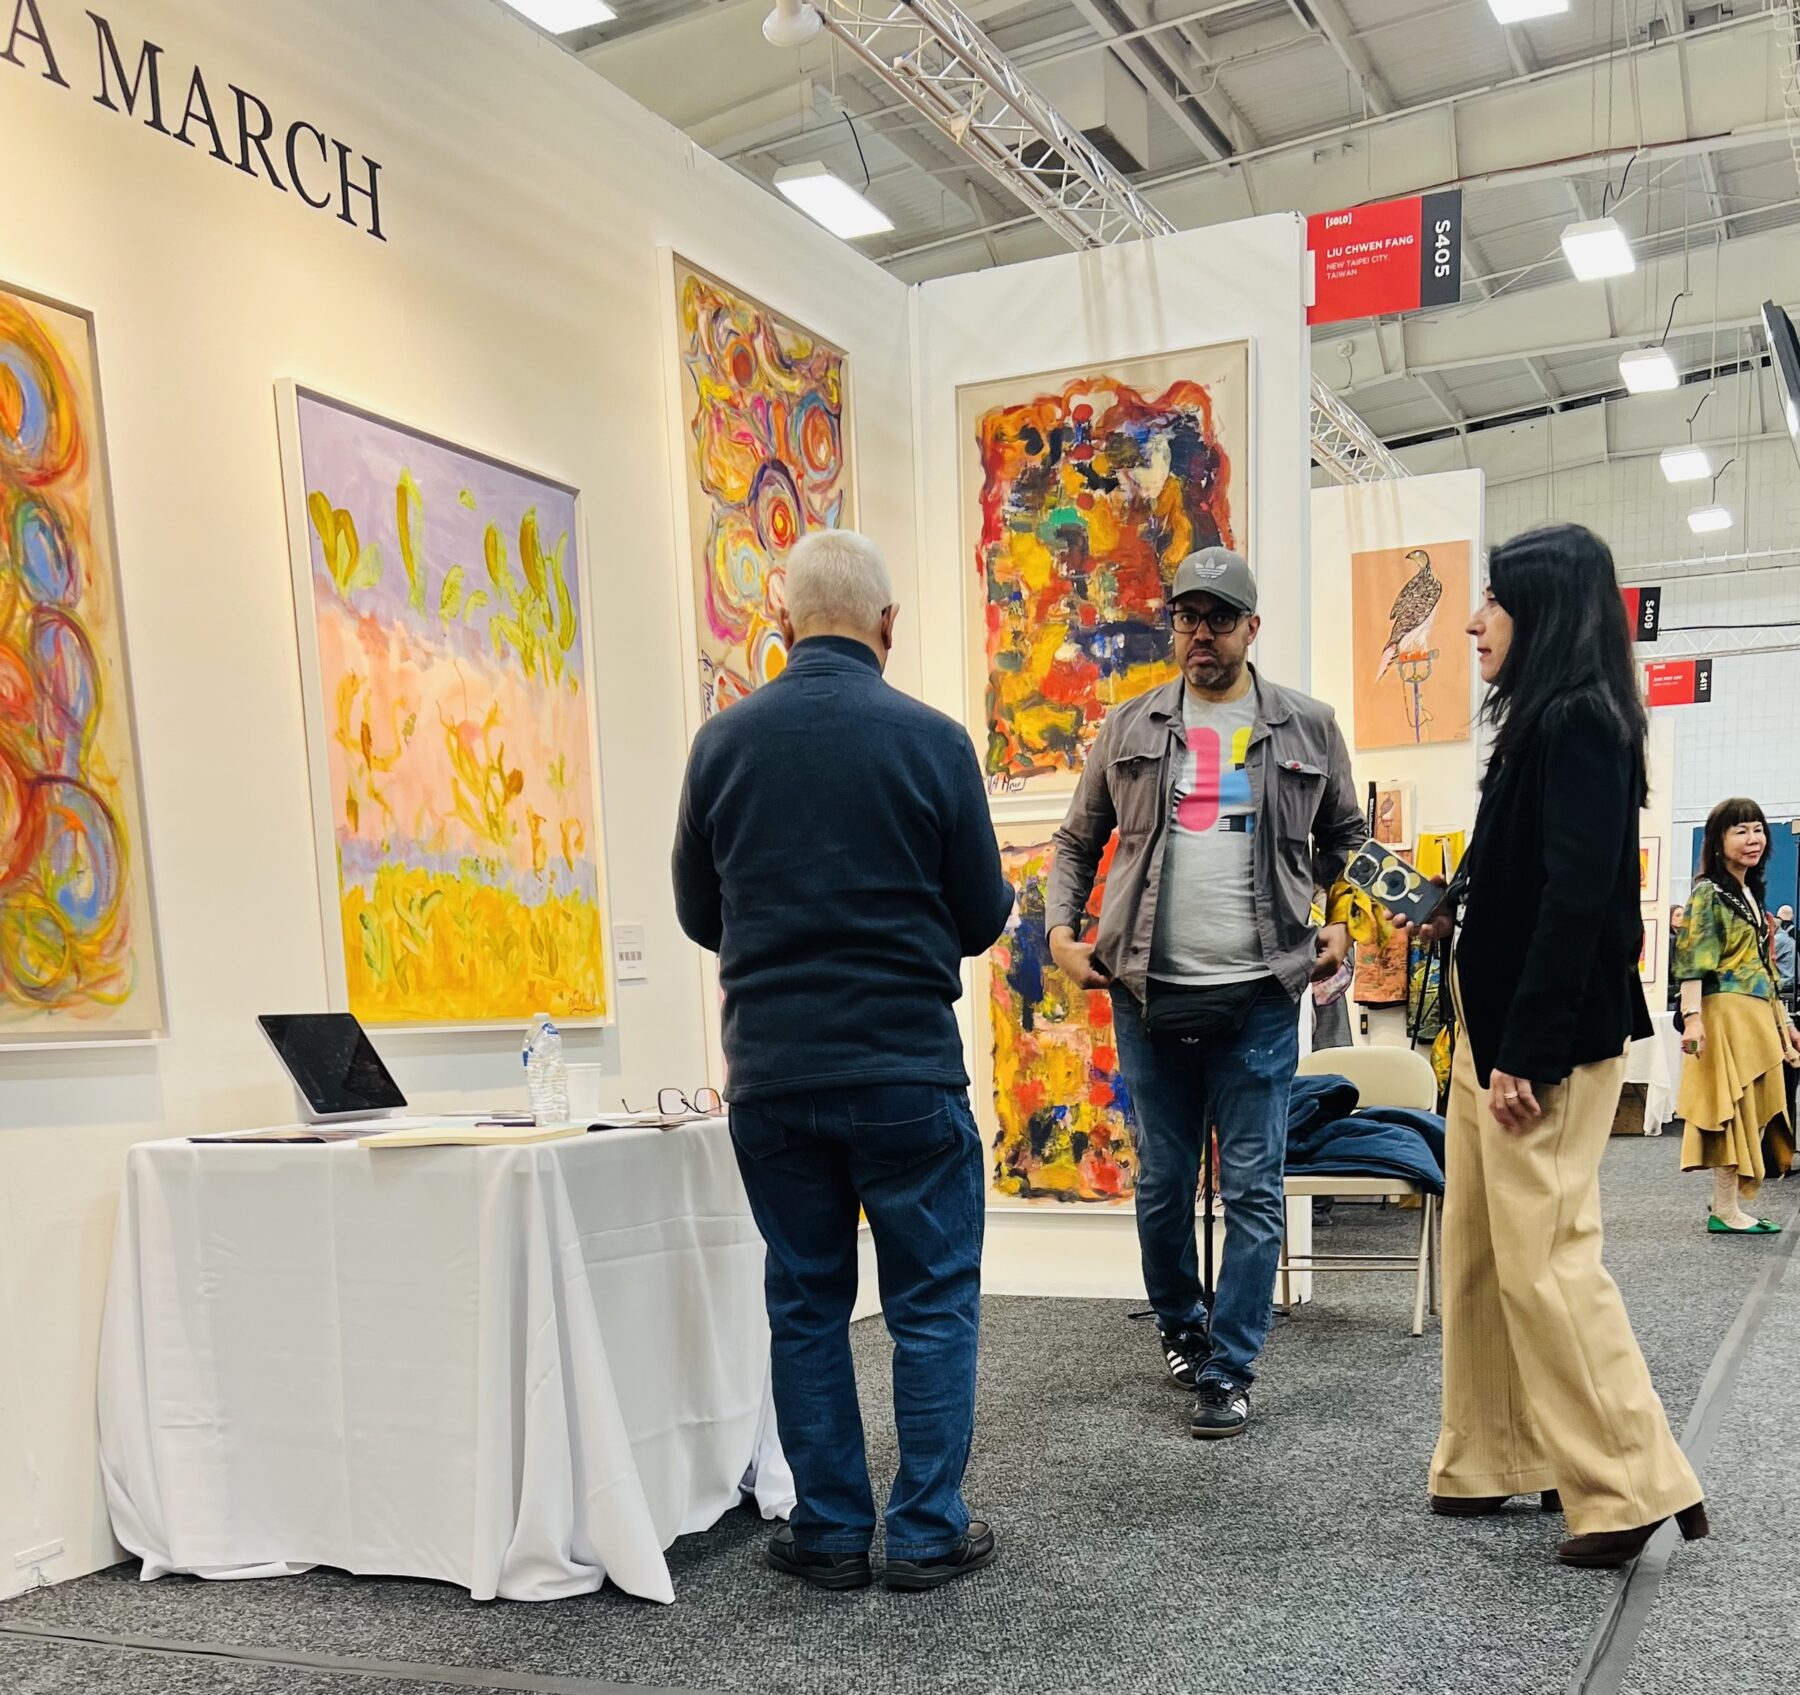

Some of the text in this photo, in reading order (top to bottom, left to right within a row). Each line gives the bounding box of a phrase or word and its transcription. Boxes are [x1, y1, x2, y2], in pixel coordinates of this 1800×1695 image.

[0, 0, 388, 242] A MARCH
[1326, 235, 1414, 258] LIU CHWEN FANG
[1434, 219, 1451, 278] S405
[1326, 261, 1345, 271] NEW
[1346, 256, 1370, 268] TAIPEI
[1326, 268, 1358, 280] TAIWAN
[1644, 600, 1655, 629] S409
[1699, 671, 1708, 691] S411
